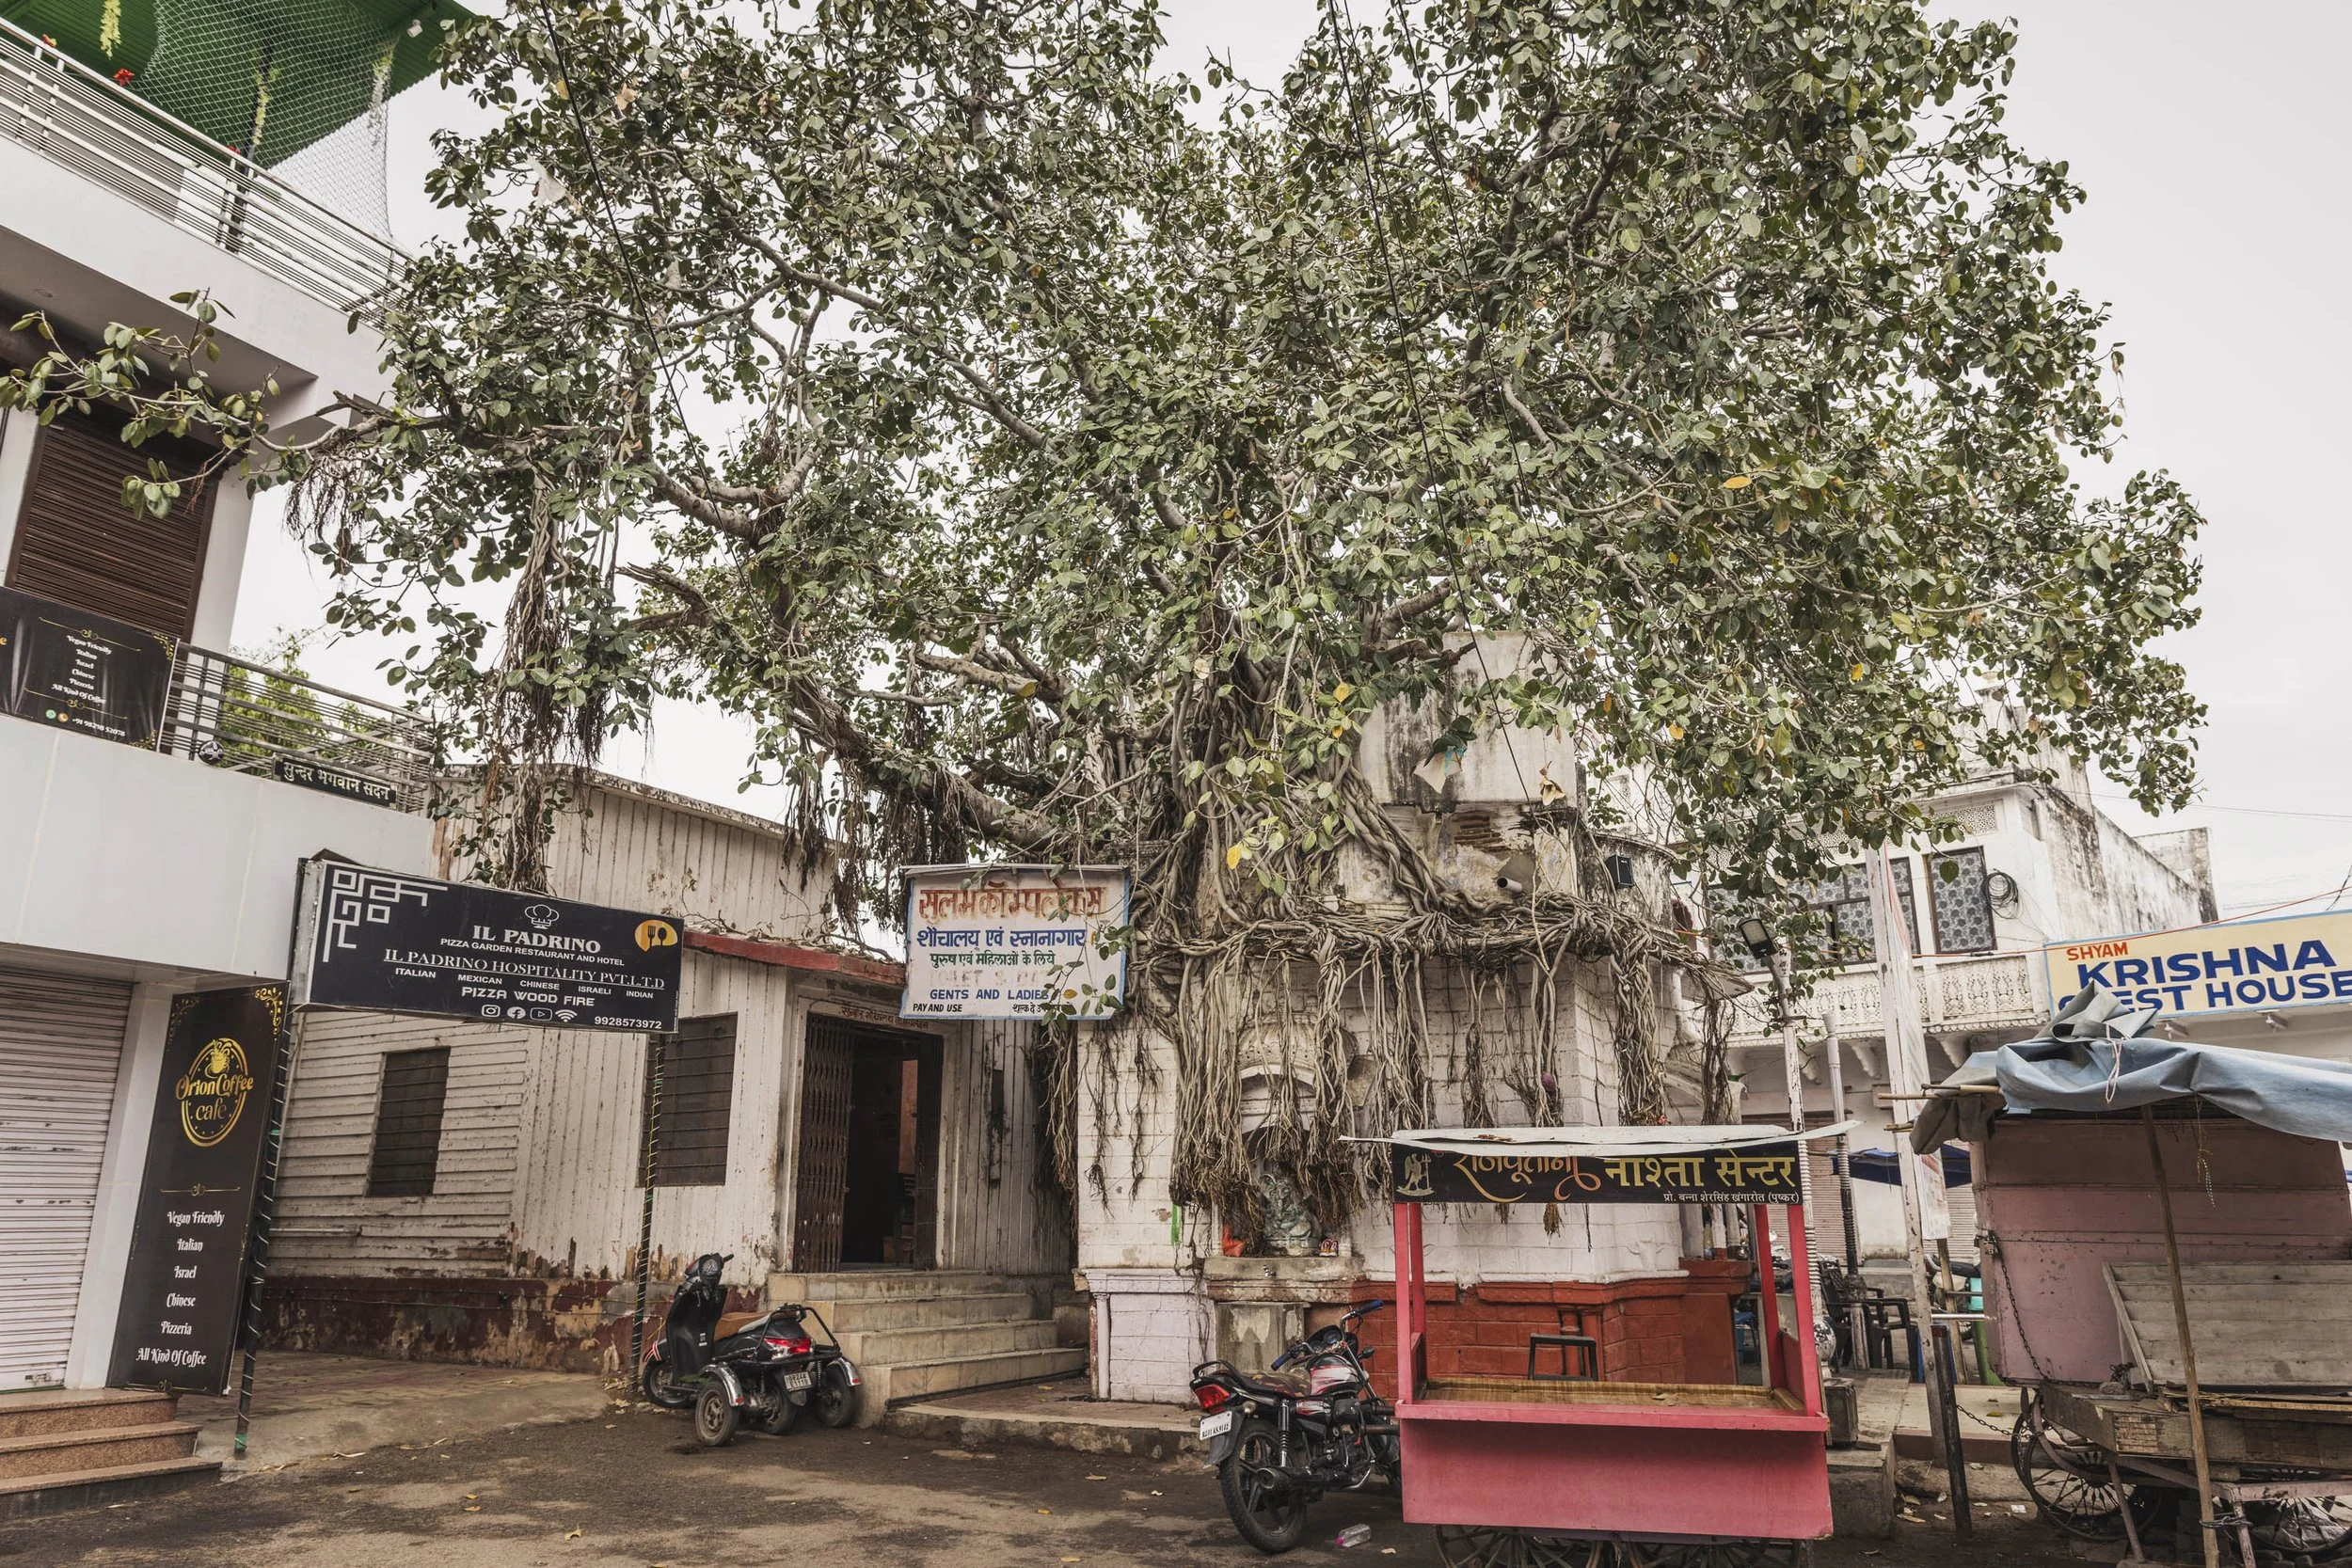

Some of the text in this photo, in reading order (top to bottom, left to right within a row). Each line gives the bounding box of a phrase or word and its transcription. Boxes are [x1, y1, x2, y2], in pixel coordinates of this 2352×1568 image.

[67, 635, 86, 647] Vegan
[284, 762, 390, 800] सुन्दर भगवान सदन
[472, 925, 601, 954] IL PADRINO
[917, 927, 1087, 948] शौचालय एवं स्नानागार
[440, 938, 625, 966] PIZZA GARDEN RESTAURANT AND HOTEL
[930, 950, 1056, 968] पुरुष एवं महिलाओं के लिये
[2066, 942, 2129, 961] SHYAM
[384, 949, 403, 961] IL
[408, 951, 488, 970] PADRINO
[493, 961, 596, 982] HOSPITALITY
[2077, 940, 2336, 989] KRISHNA
[395, 967, 653, 999] ITALIAN MEXICAN CHINESE ISRAELI INDIAN
[2058, 970, 2352, 1012] EST HOUSE
[461, 987, 596, 1007] PIZZA WOOD FIRE
[930, 989, 969, 1000] GENTS
[977, 989, 1000, 999] AND
[913, 1004, 962, 1013] PAY AND USE
[595, 1016, 662, 1030] 9928573972
[1603, 1157, 1705, 1188] नाश्ता
[1715, 1149, 1797, 1188] सेन्टर
[1700, 1191, 1730, 1202] शेरसिंह
[1769, 1192, 1799, 1204] (पुष्कर)
[167, 1210, 225, 1227] Vegan Friendly
[177, 1237, 204, 1252] Italian
[174, 1265, 197, 1279] Israel
[167, 1292, 196, 1308] Chinese
[160, 1321, 192, 1335] Pizzeria
[136, 1347, 207, 1368] All Kind Of Coffee
